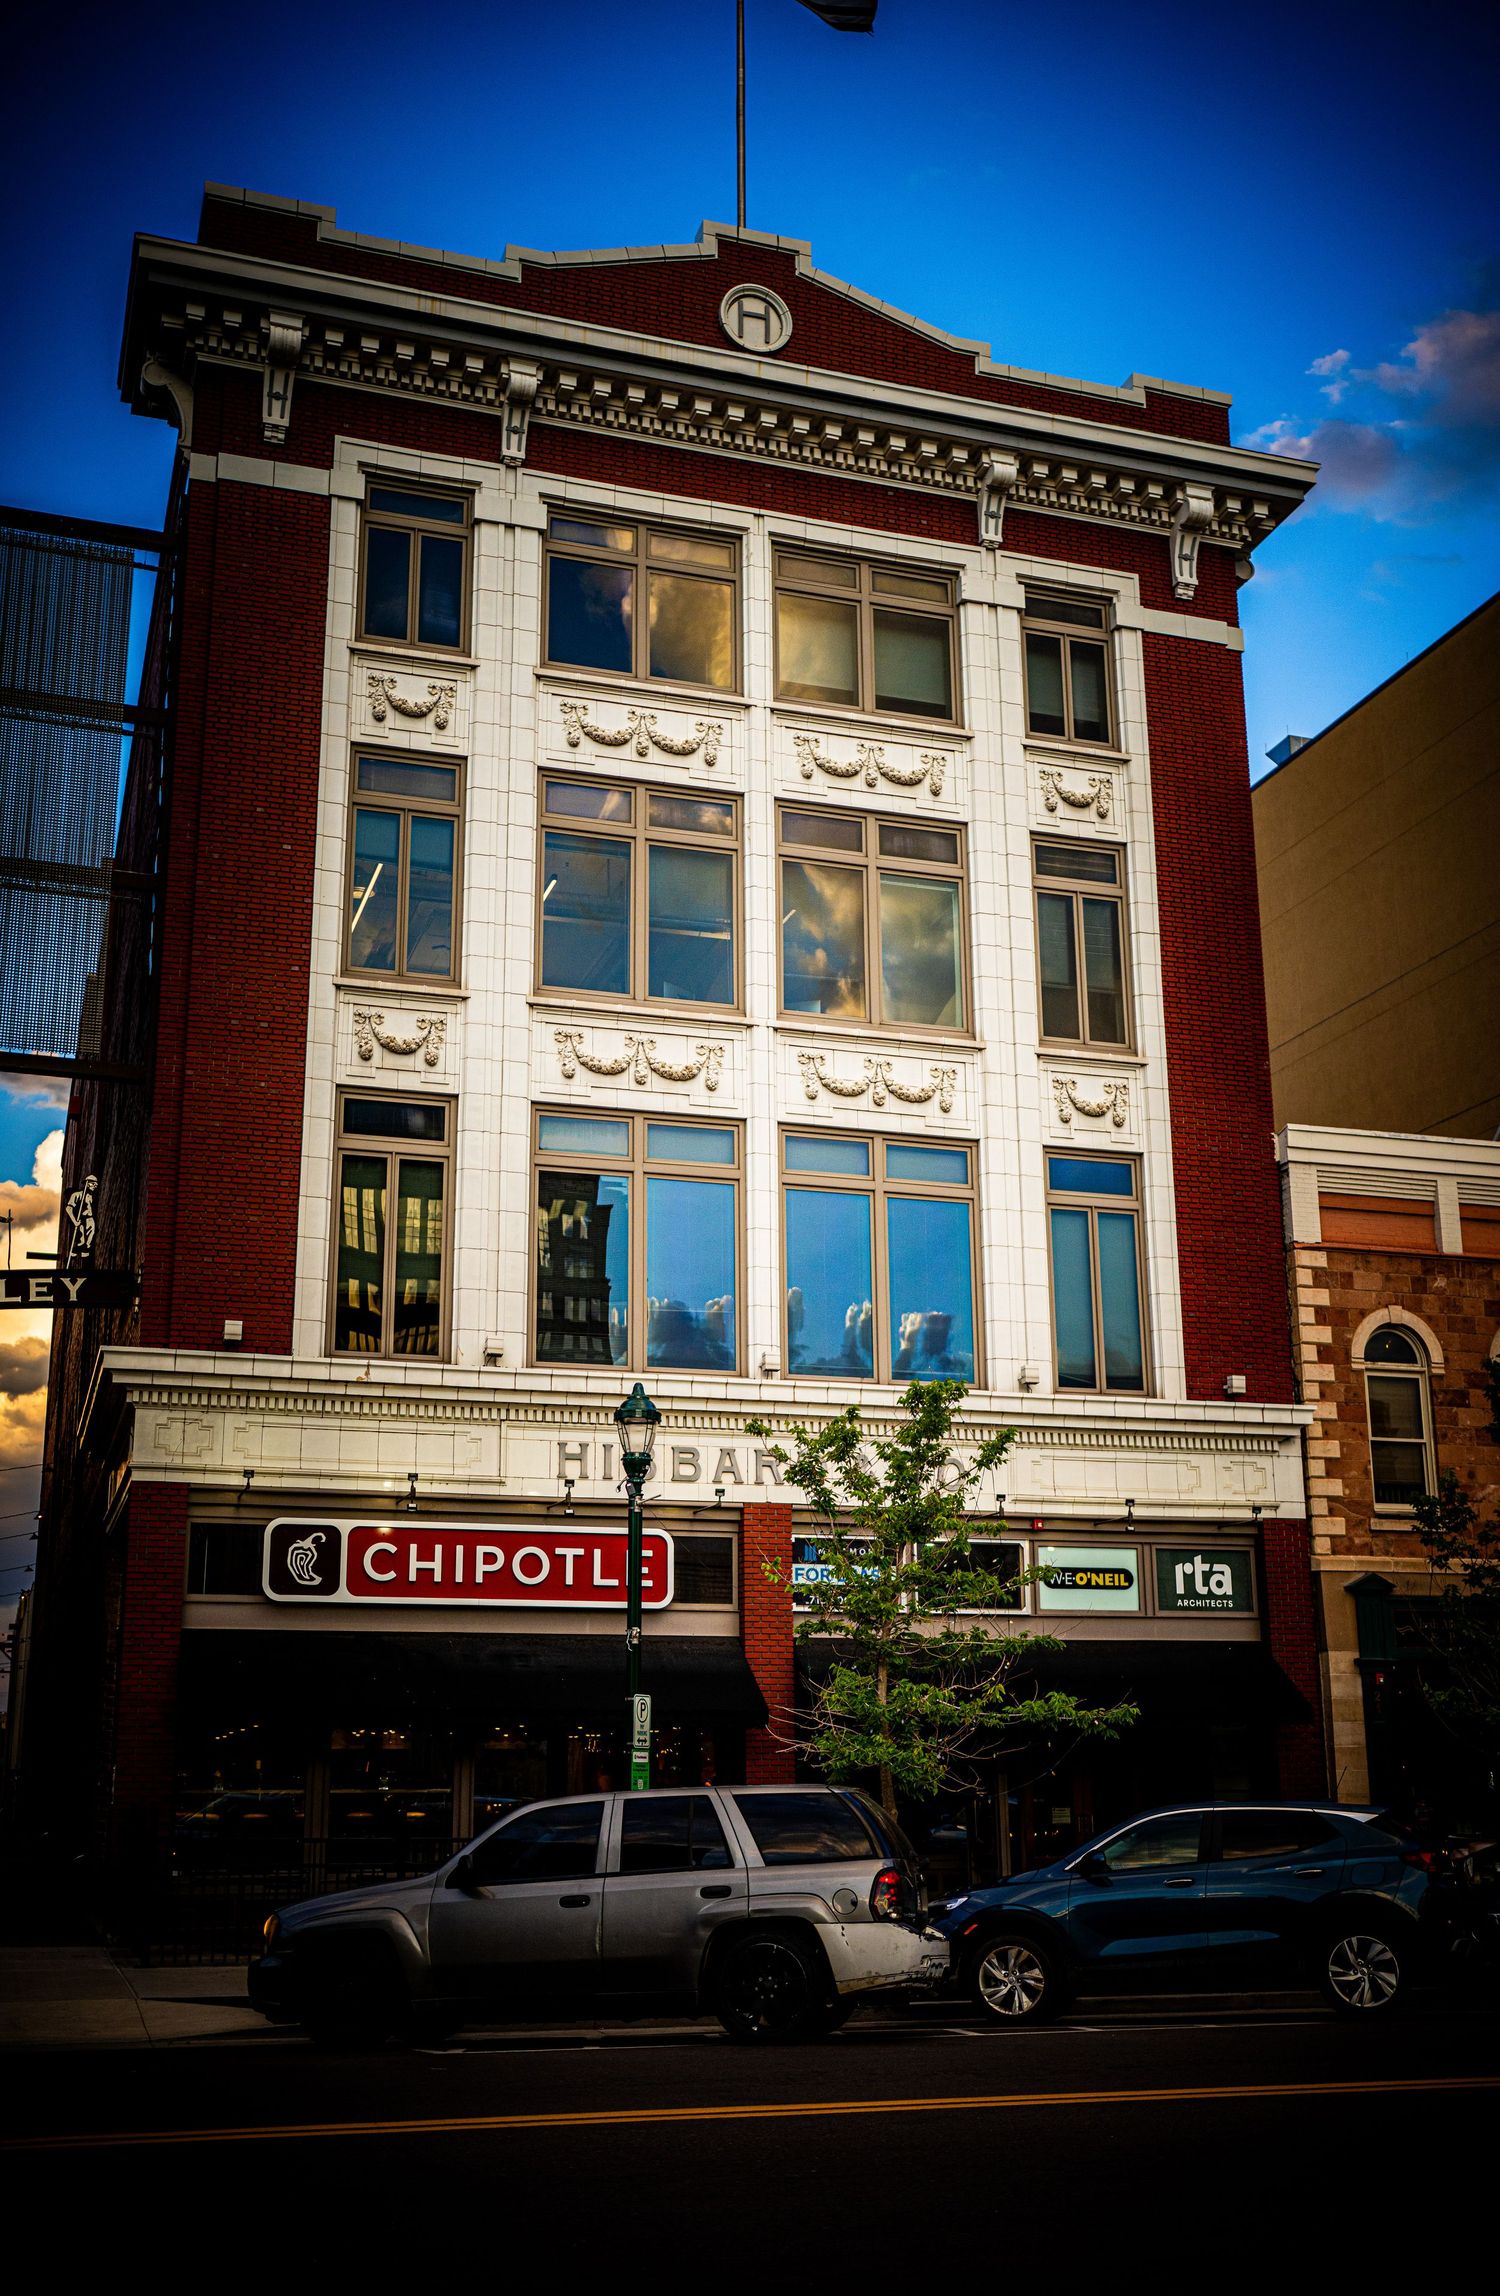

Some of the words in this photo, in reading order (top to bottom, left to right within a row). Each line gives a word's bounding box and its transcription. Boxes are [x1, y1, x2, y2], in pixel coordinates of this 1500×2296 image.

[737, 300, 771, 344] H
[0, 1277, 87, 1303] LEY
[557, 1441, 828, 1487] HIBAR
[363, 1542, 653, 1587] CHIPOTLE
[794, 1567, 831, 1582] FOR
[1175, 1554, 1234, 1596] rta
[1177, 1598, 1234, 1608] ARCHITECTS
